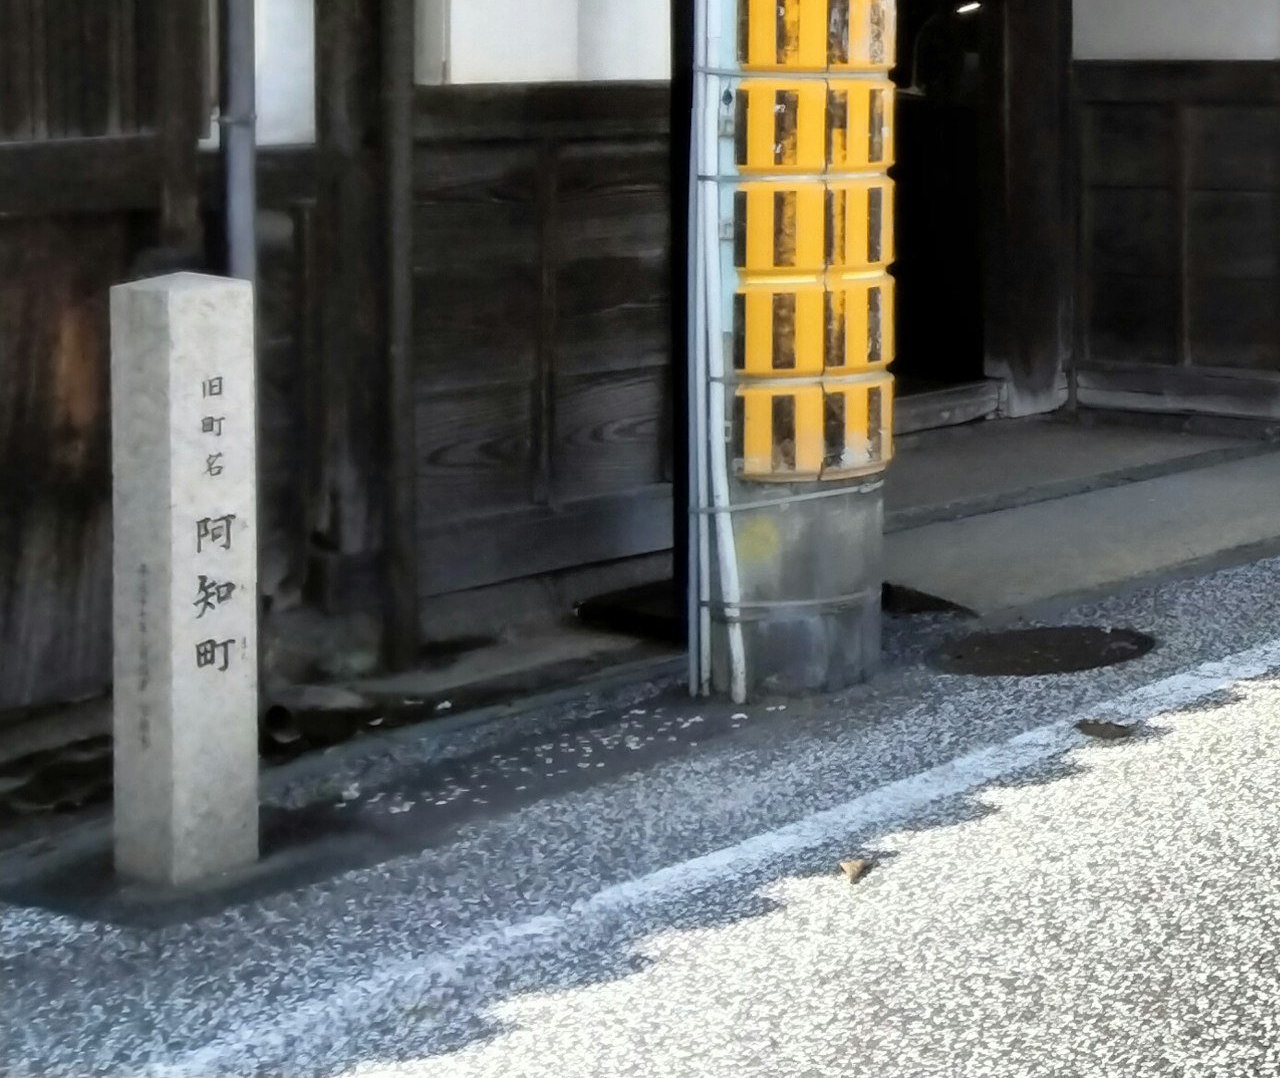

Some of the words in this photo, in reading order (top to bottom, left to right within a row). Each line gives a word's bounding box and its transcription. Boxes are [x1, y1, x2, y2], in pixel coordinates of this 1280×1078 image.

[201, 376, 226, 477] 旧町名
[192, 513, 236, 672] 阿知町
